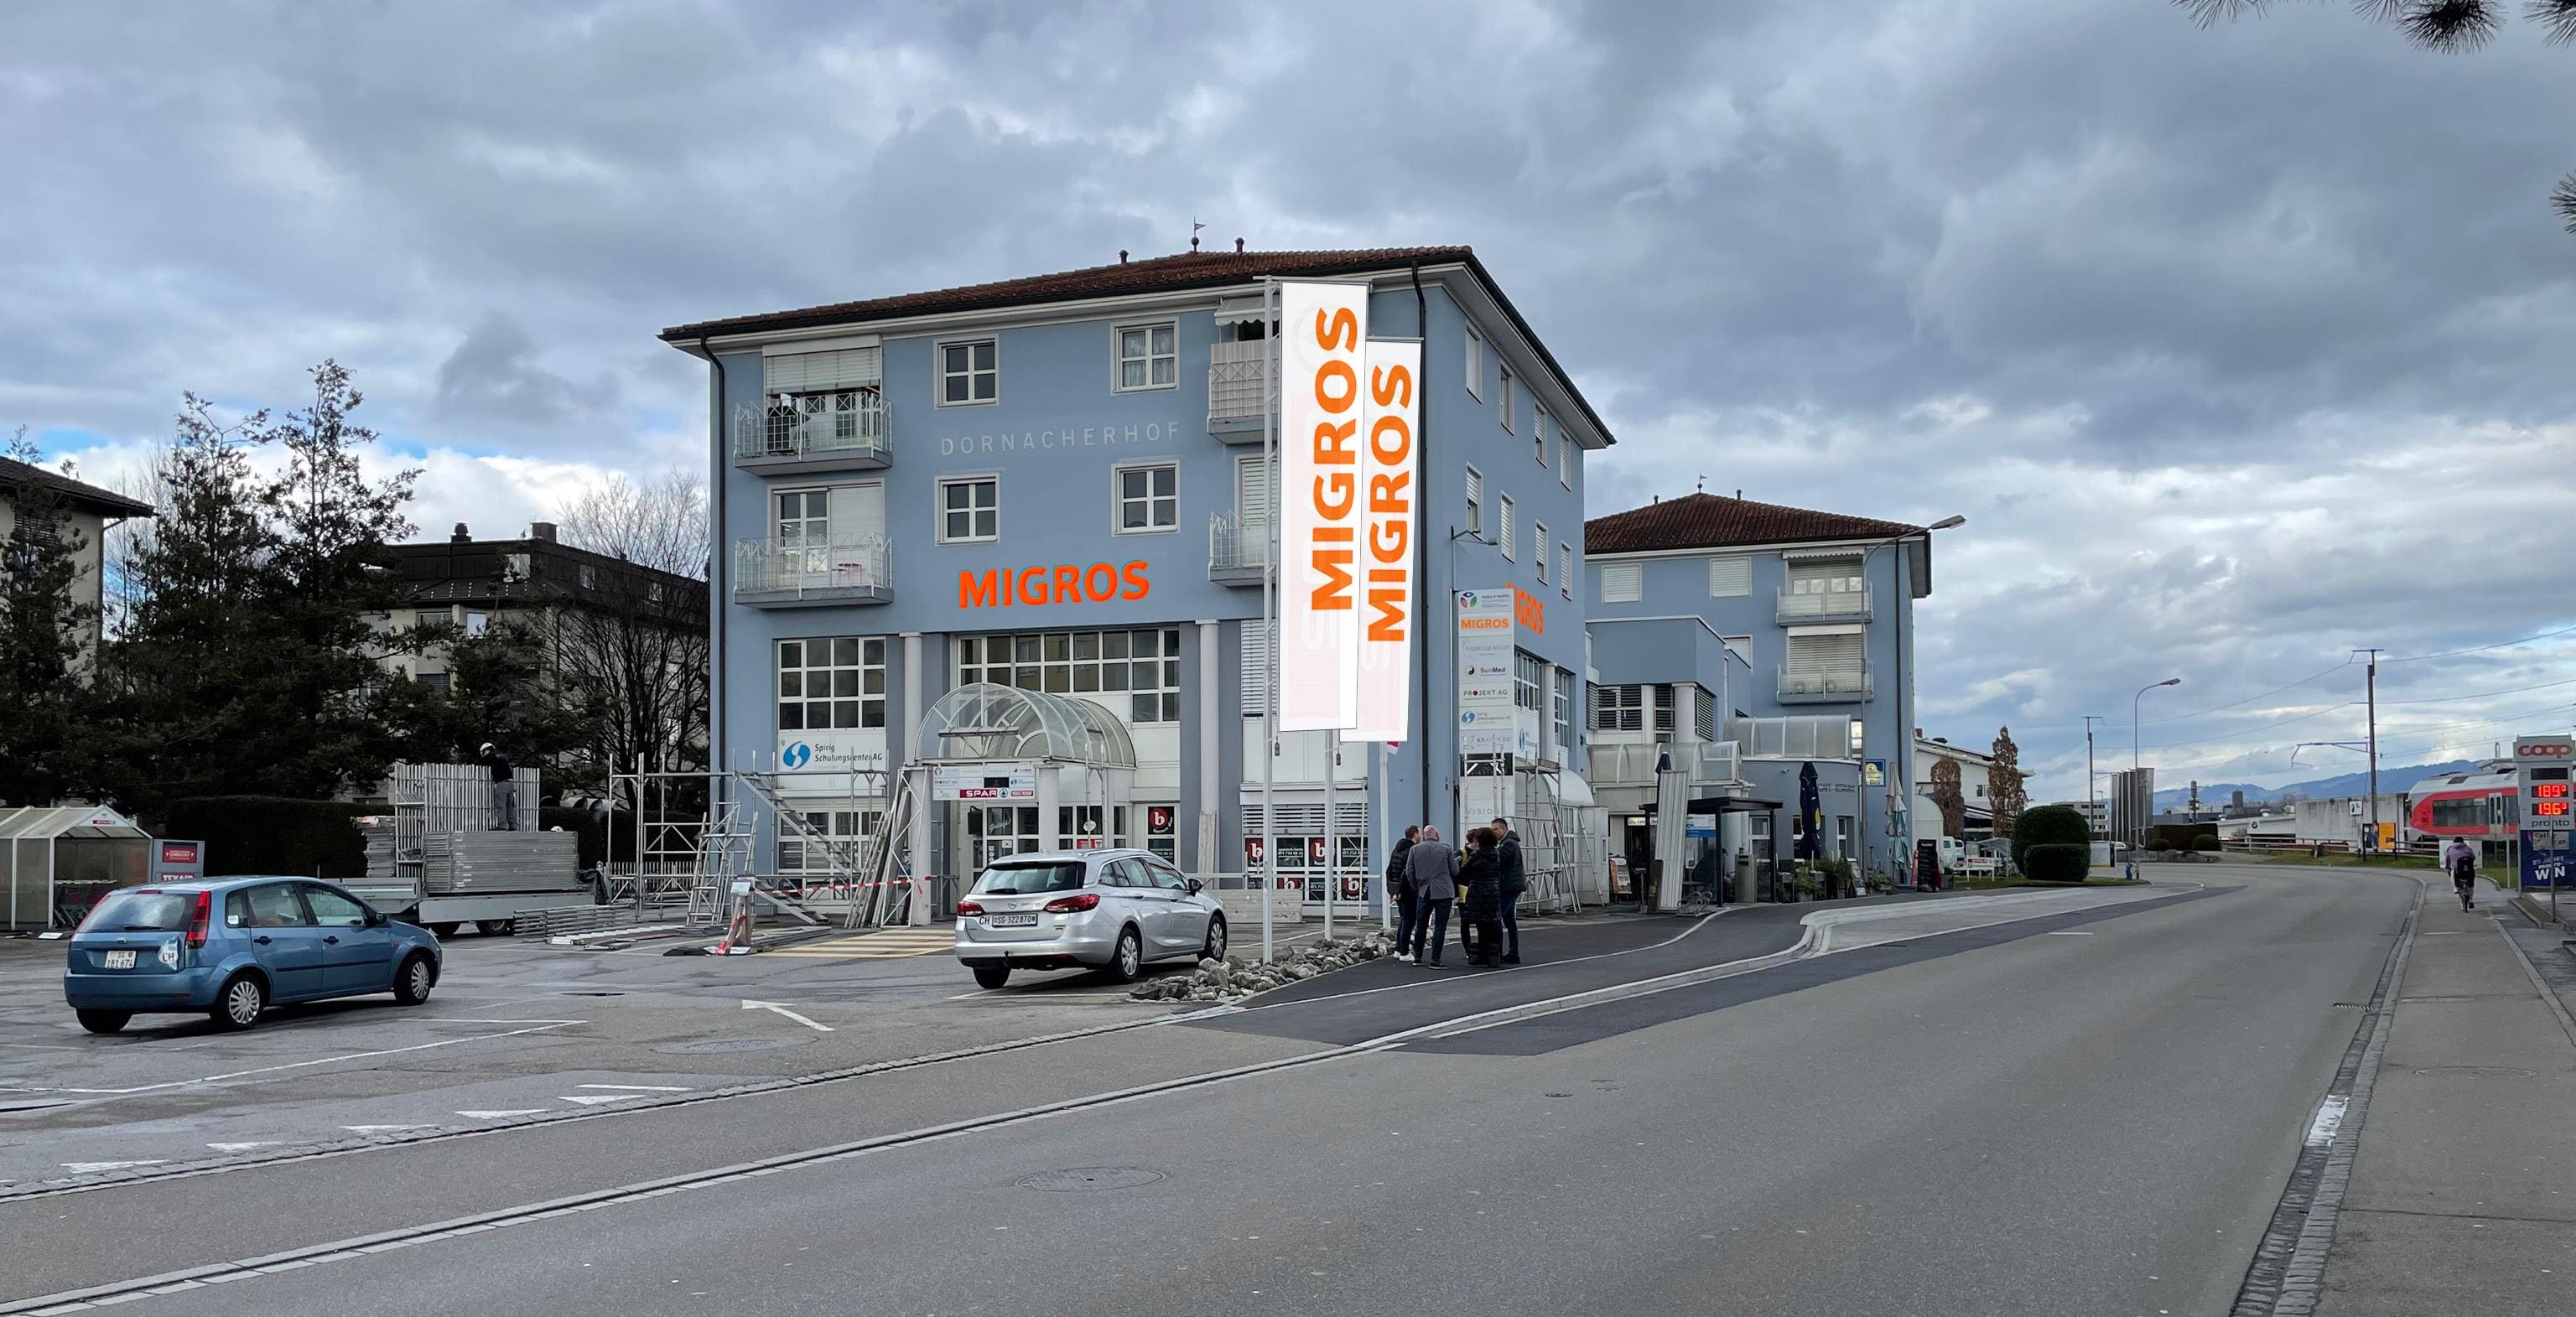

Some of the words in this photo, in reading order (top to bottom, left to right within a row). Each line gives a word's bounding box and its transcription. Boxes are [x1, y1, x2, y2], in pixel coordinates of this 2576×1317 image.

[941, 421, 1180, 456] DORNACHERHOF
[1311, 307, 1358, 611] MIGROS
[1367, 364, 1412, 642] MIGROS
[958, 560, 1150, 609] MIGROS
[1460, 619, 1509, 630] MIGROS
[814, 744, 835, 752] Spirig
[2518, 744, 2573, 759] coop
[872, 753, 883, 761] AG
[2532, 820, 2570, 828] pronto
[2534, 866, 2566, 881] WN
[979, 916, 990, 926] CH
[1007, 914, 1032, 923] 322870
